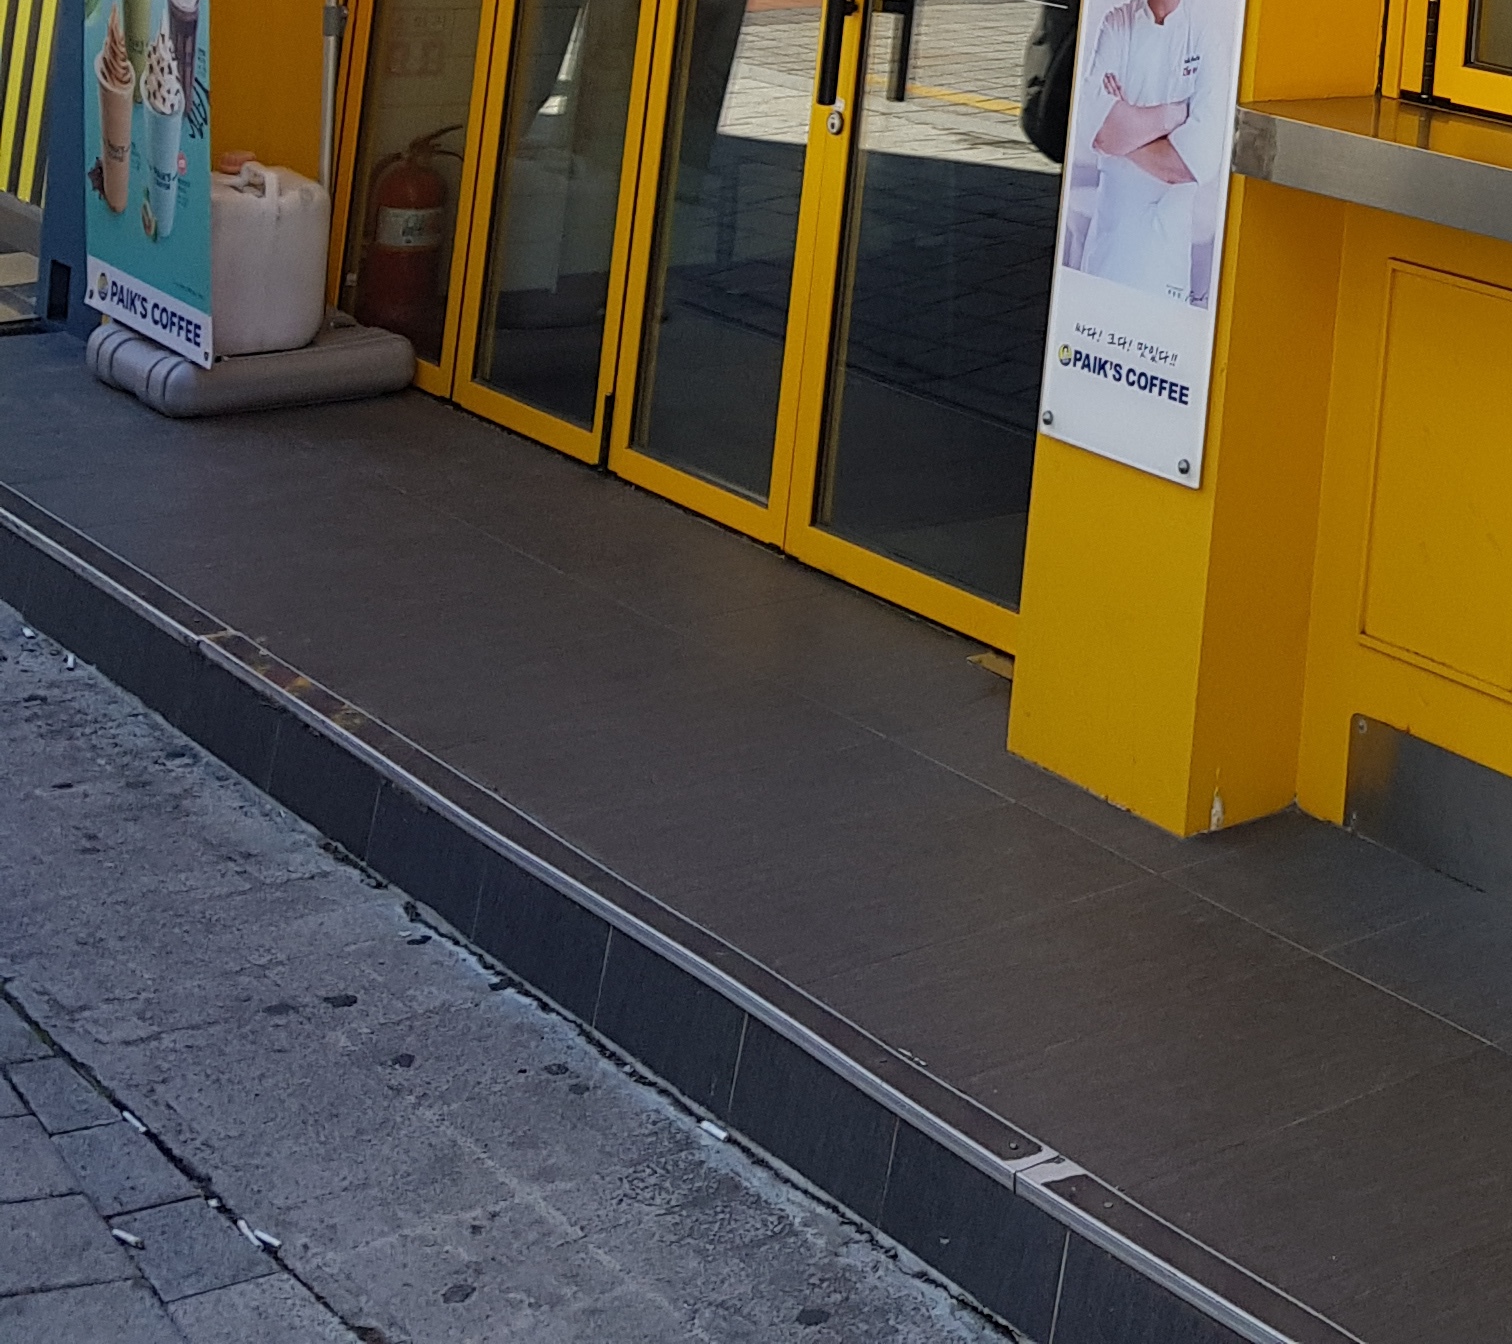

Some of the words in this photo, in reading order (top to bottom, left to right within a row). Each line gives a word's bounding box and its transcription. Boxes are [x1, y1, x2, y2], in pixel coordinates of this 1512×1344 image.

[110, 280, 148, 320] PAIK'S
[151, 302, 202, 349] COFFEE
[1072, 349, 1123, 383] PAIK'S
[1125, 367, 1190, 406] COFFEE
